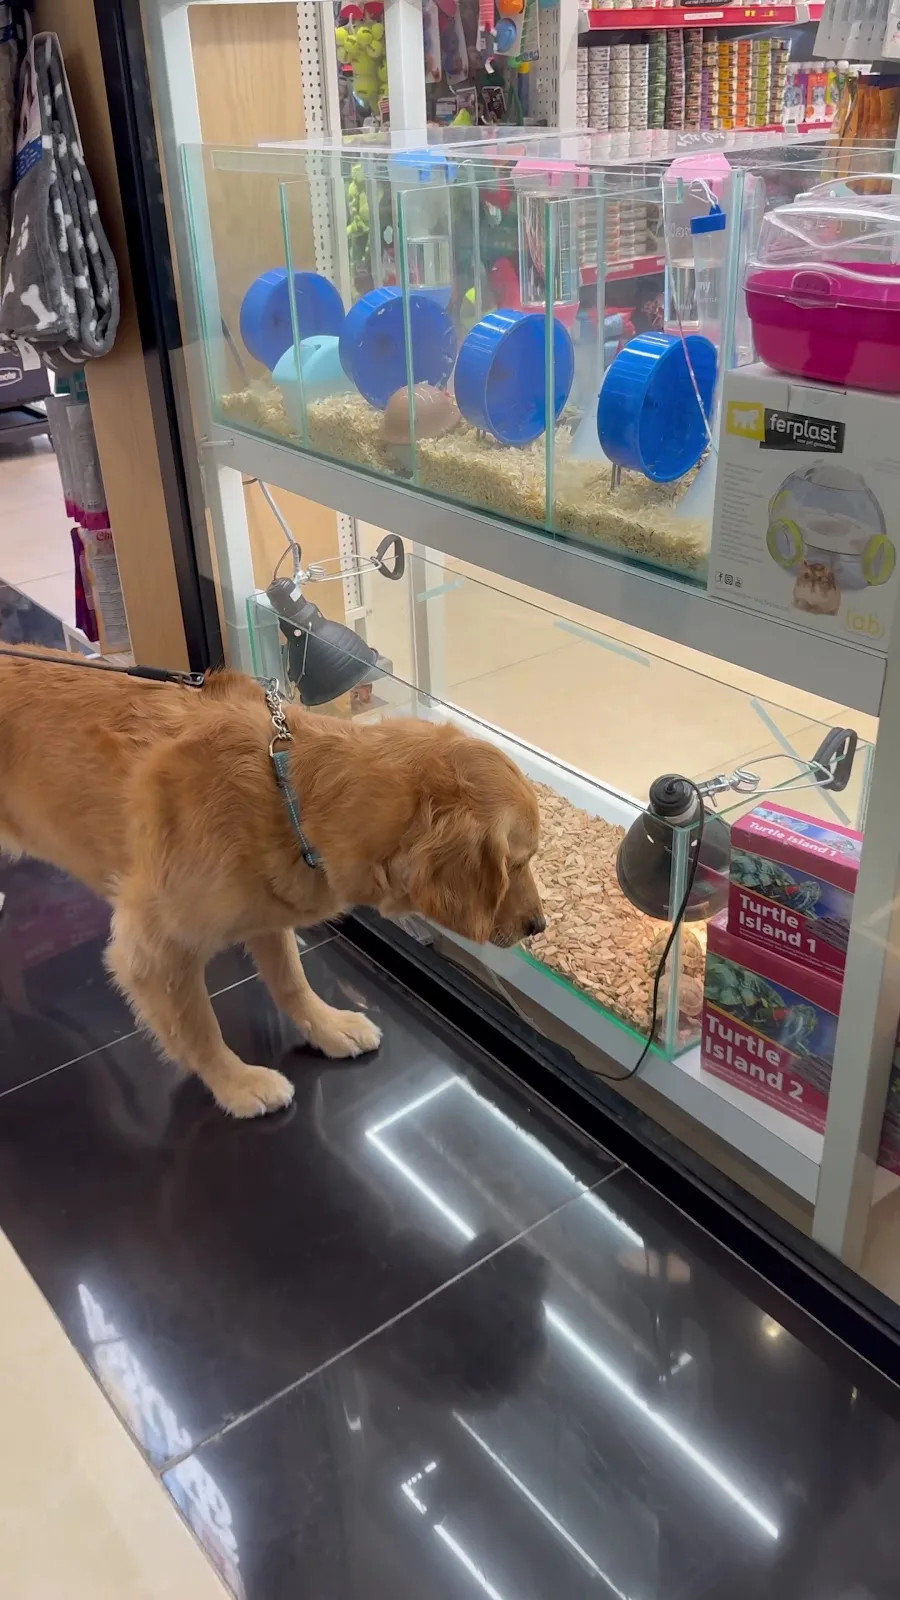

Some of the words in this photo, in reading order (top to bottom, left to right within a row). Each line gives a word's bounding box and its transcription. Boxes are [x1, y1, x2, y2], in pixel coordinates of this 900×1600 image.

[770, 414, 837, 443] ferplast
[749, 822, 785, 839] Turtle
[787, 835, 829, 855] Island
[740, 894, 799, 929] Turtle
[739, 911, 801, 947] Island
[807, 938, 816, 953] 1
[706, 1014, 780, 1067] Turtle
[705, 1036, 783, 1091] Island
[788, 1080, 804, 1103] 2
